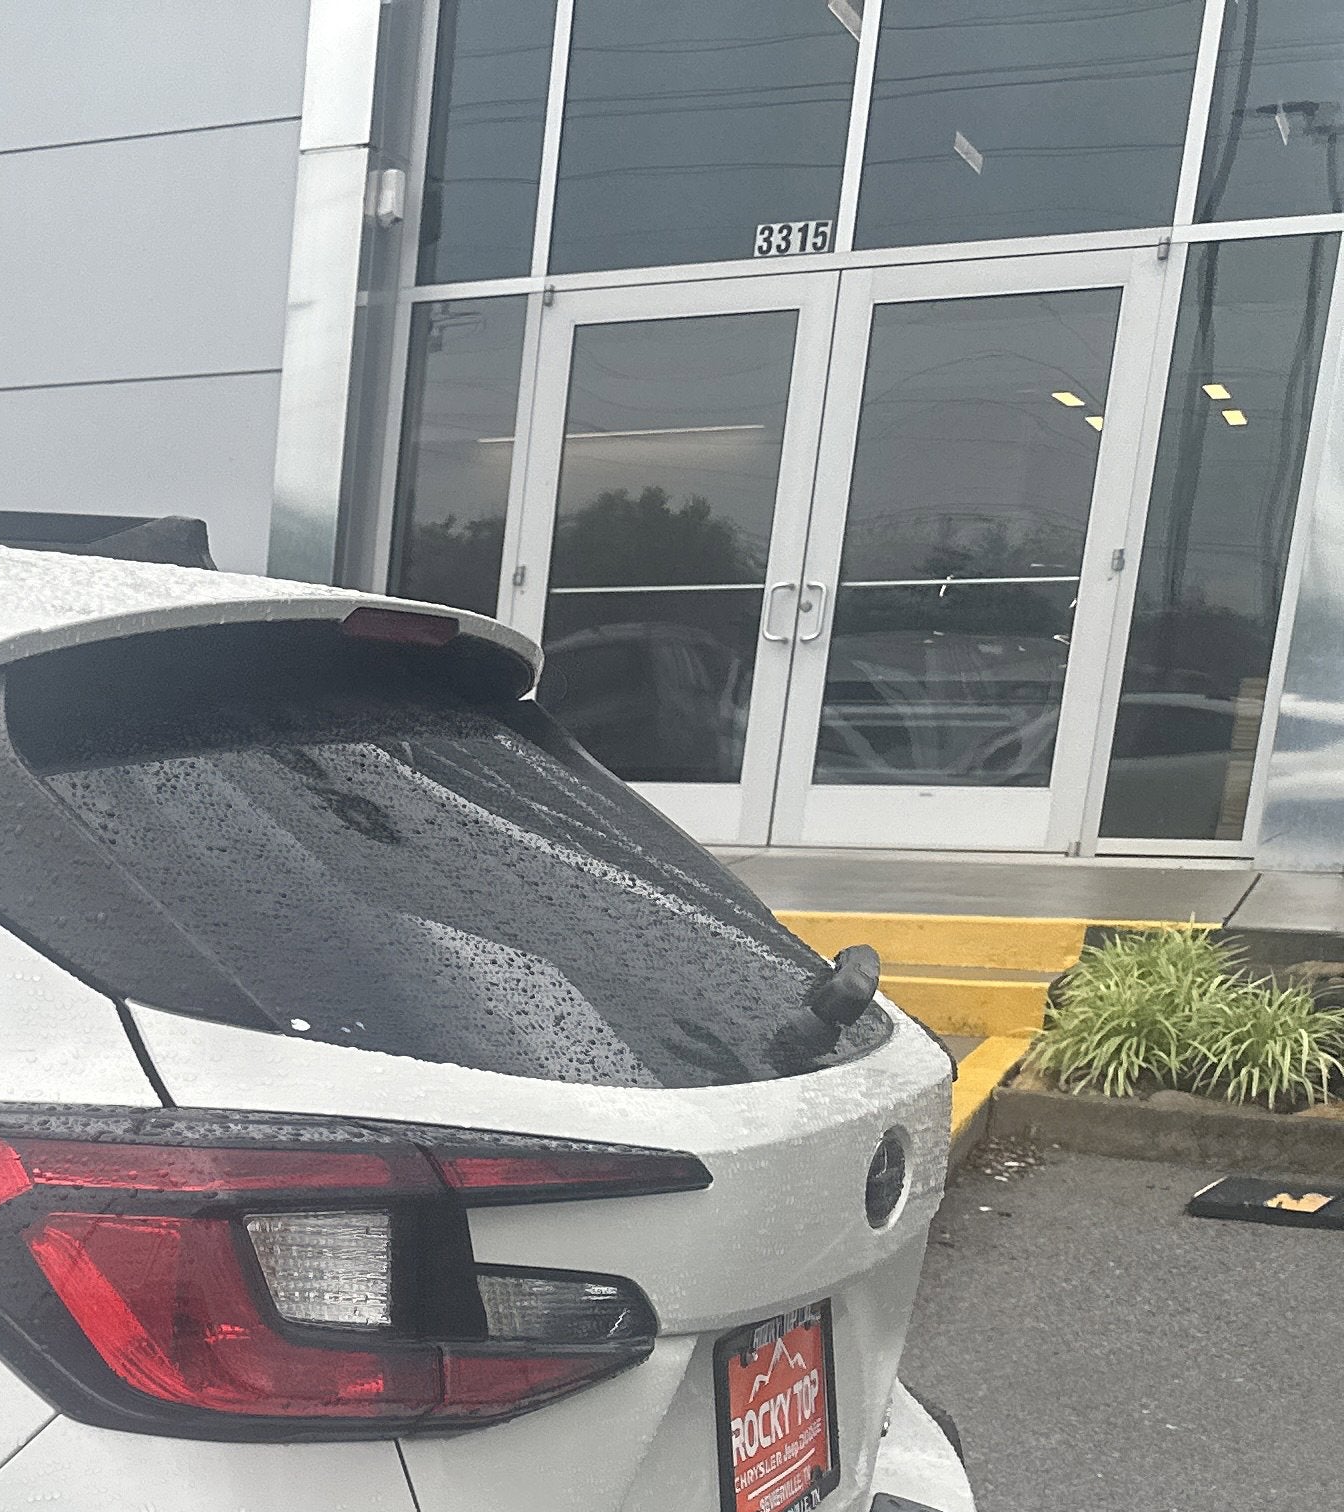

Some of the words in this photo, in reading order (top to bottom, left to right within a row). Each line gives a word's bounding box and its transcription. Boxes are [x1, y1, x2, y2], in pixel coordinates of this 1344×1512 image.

[757, 222, 829, 255] 3315
[730, 1387, 791, 1467] ROCKY
[792, 1368, 819, 1426] TOP
[734, 1451, 783, 1494] CHRYSLER
[783, 1440, 800, 1462] Jeep
